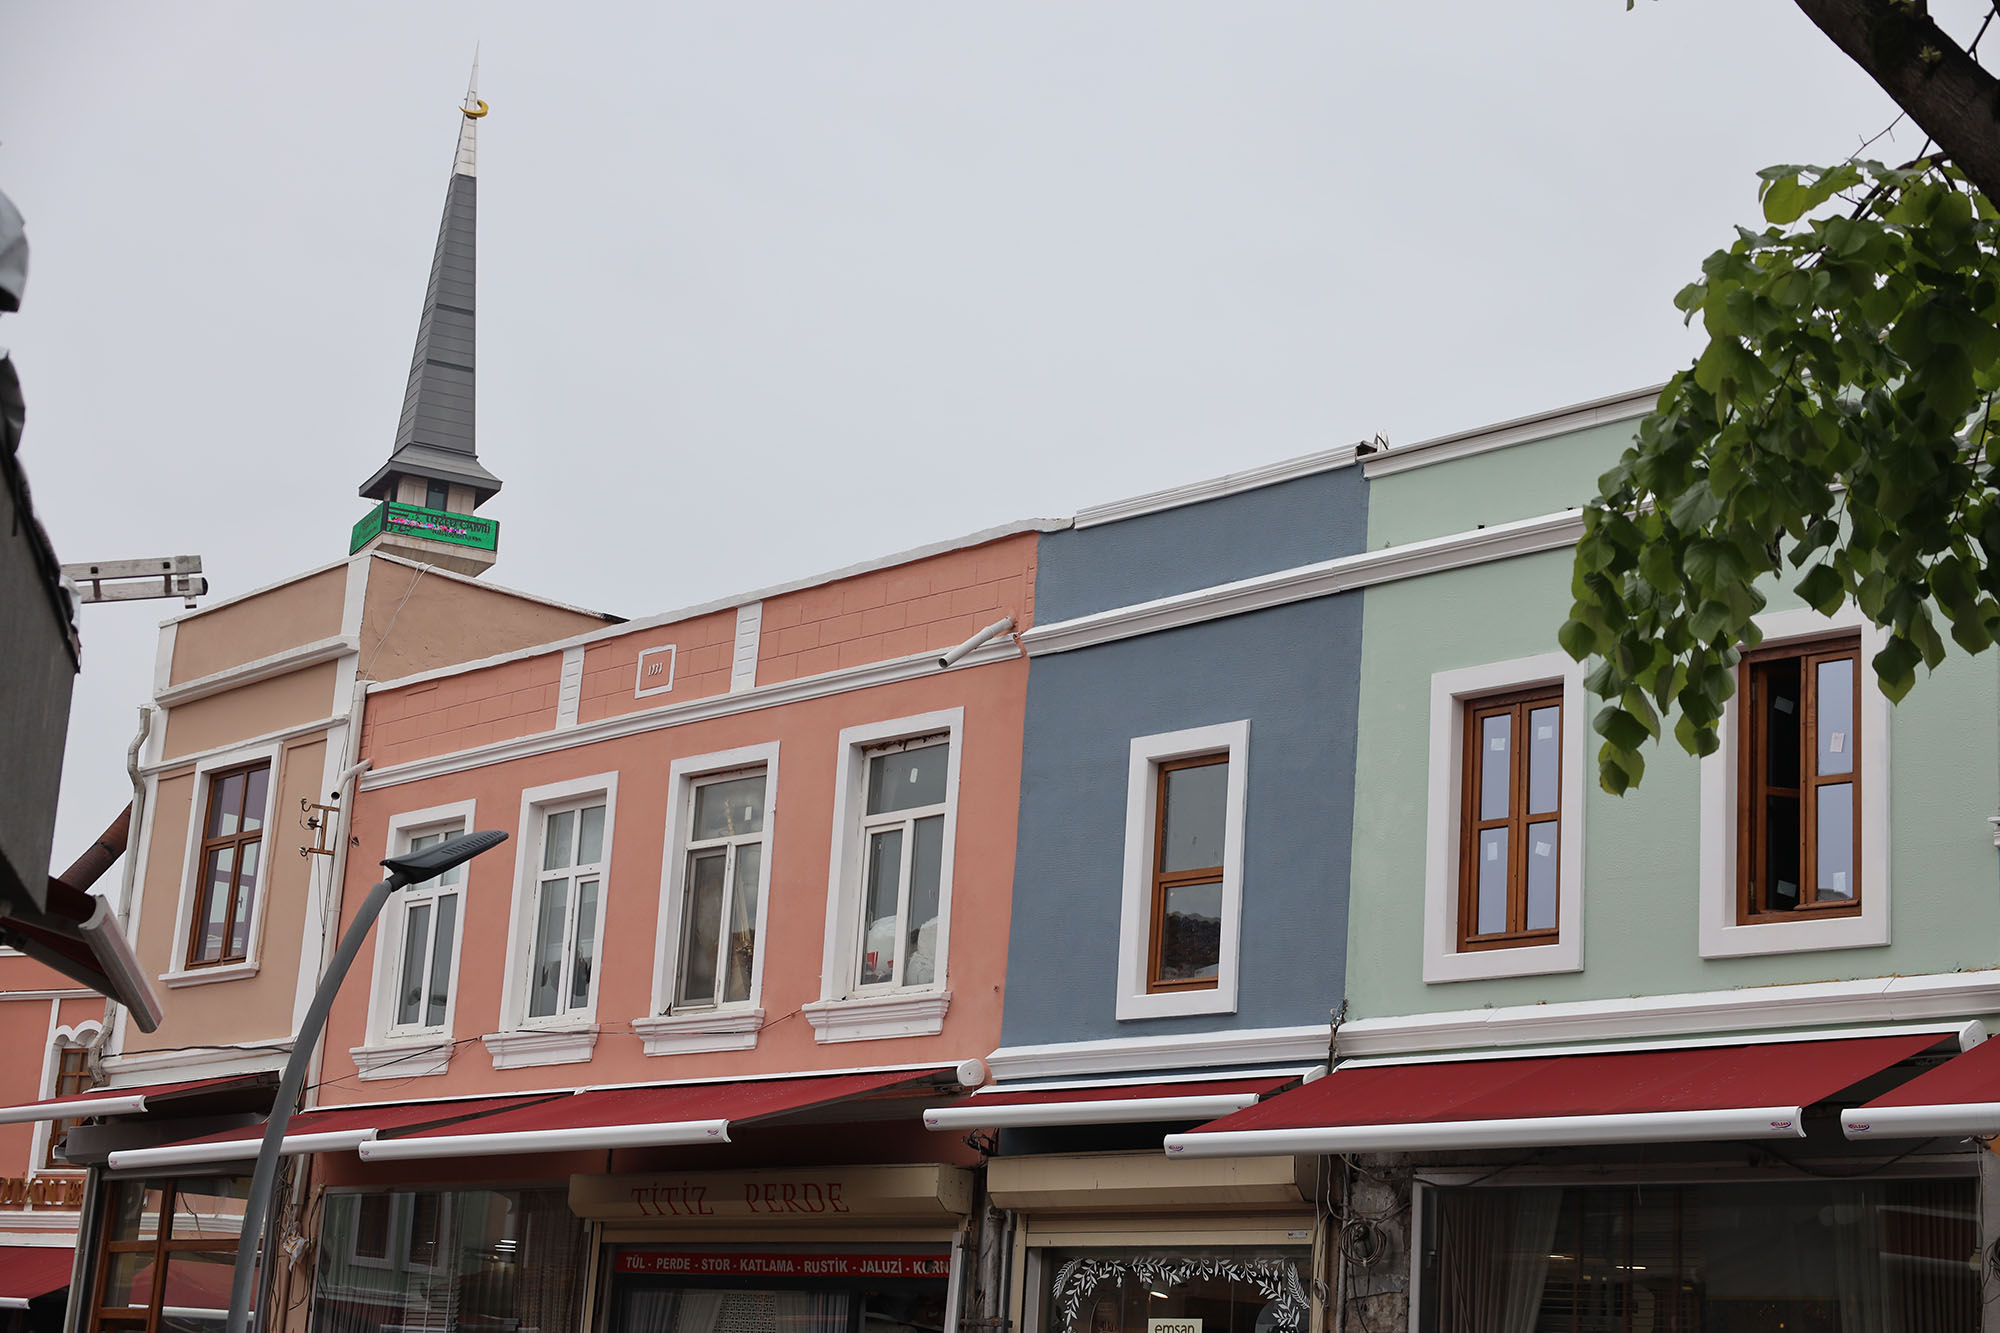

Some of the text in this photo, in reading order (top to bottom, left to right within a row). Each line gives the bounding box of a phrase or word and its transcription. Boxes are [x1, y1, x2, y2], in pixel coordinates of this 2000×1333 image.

[631, 1181, 849, 1216] TİTİZ PERDE
[626, 1255, 952, 1274] TÜL PERDE STOR KATLAMA RUSTİK JALUZİ KRN
